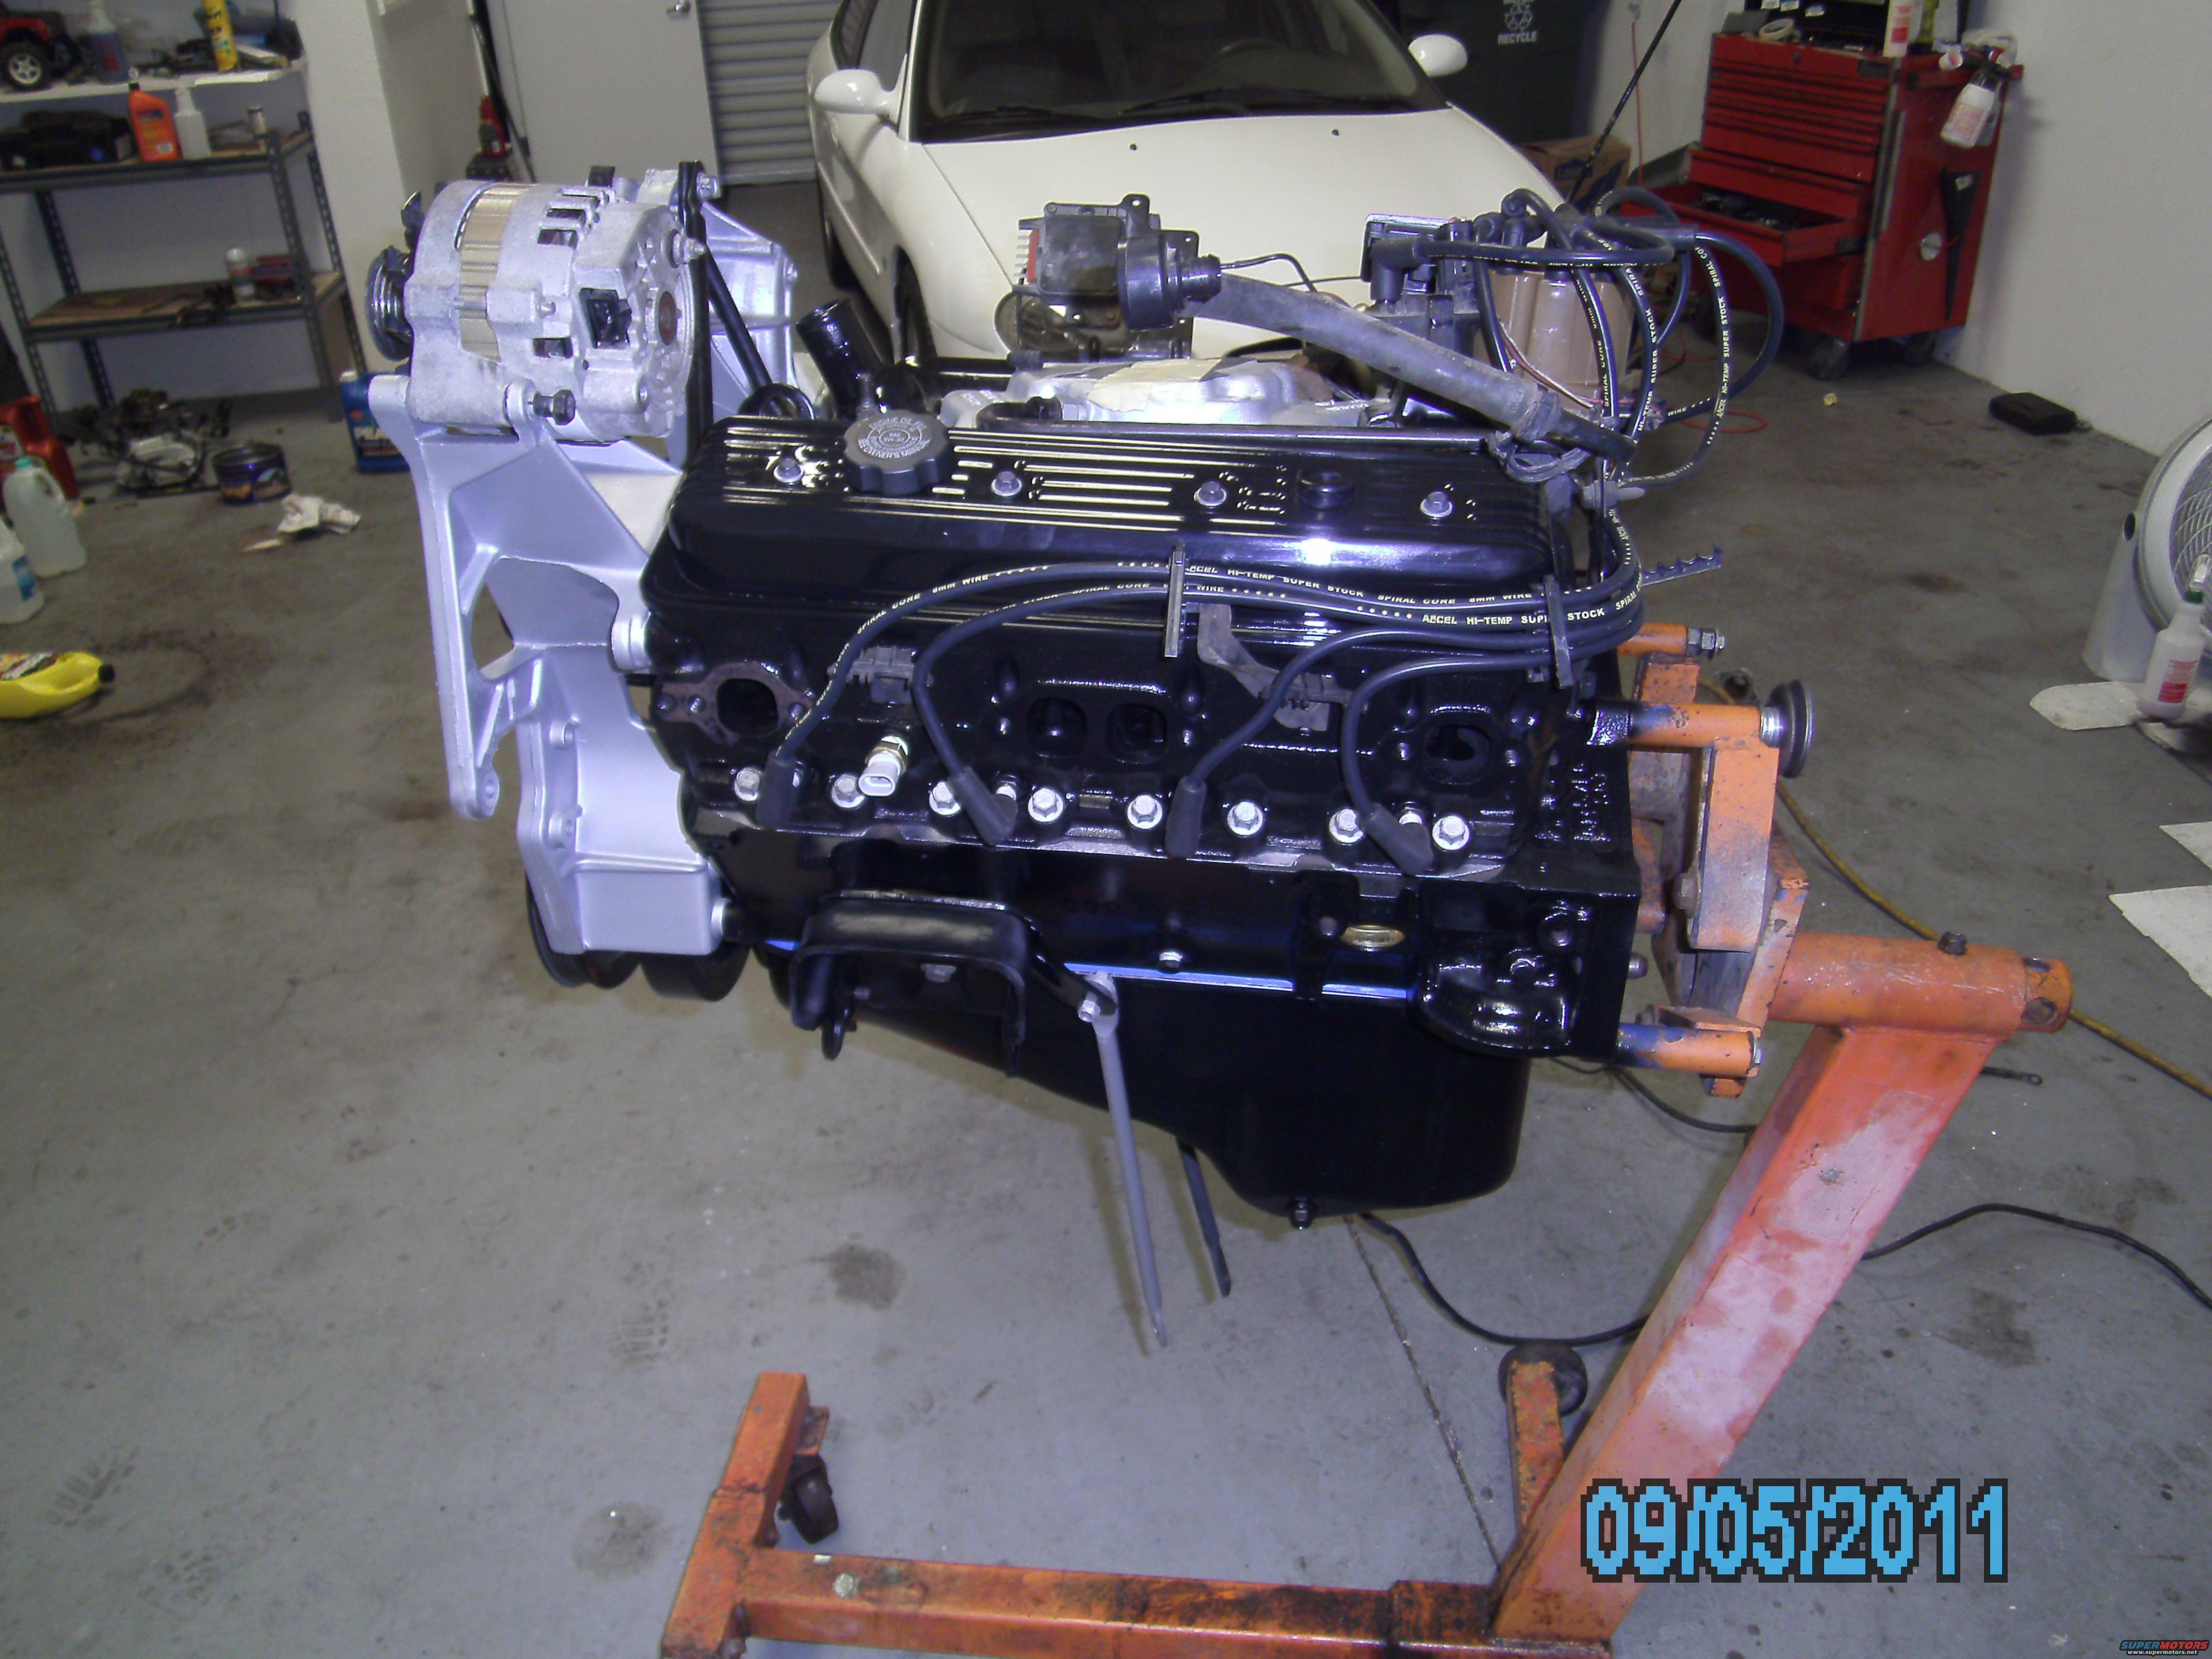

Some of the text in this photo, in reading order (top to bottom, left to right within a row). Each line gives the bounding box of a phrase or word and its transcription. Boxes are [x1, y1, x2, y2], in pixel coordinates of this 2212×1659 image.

[1498, 31, 1537, 45] RECYCLE
[1695, 247, 1707, 259] CO
[1625, 268, 1644, 296] SPIRA
[1706, 261, 1721, 287] SPIRAL
[1646, 308, 1657, 343] STOCK
[1718, 296, 1728, 325] STOCK
[1721, 363, 1729, 394] HI-TEMP
[1637, 391, 1653, 431] HI-TEMP
[1196, 584, 1224, 593] WIRE
[1227, 569, 1275, 580] HI-TEMP
[1282, 576, 1320, 589] SUPER
[1327, 585, 1364, 597] STOCK
[1377, 594, 1416, 604] SPIRAL
[857, 610, 886, 634] SPIRAL
[891, 593, 921, 609] CORE
[962, 574, 988, 585] WIRE
[1466, 616, 1513, 626] HI-TEMP
[1520, 615, 1548, 624] SUP
[1567, 608, 1605, 621] STOCK
[1615, 591, 1636, 610] SPIRAL
